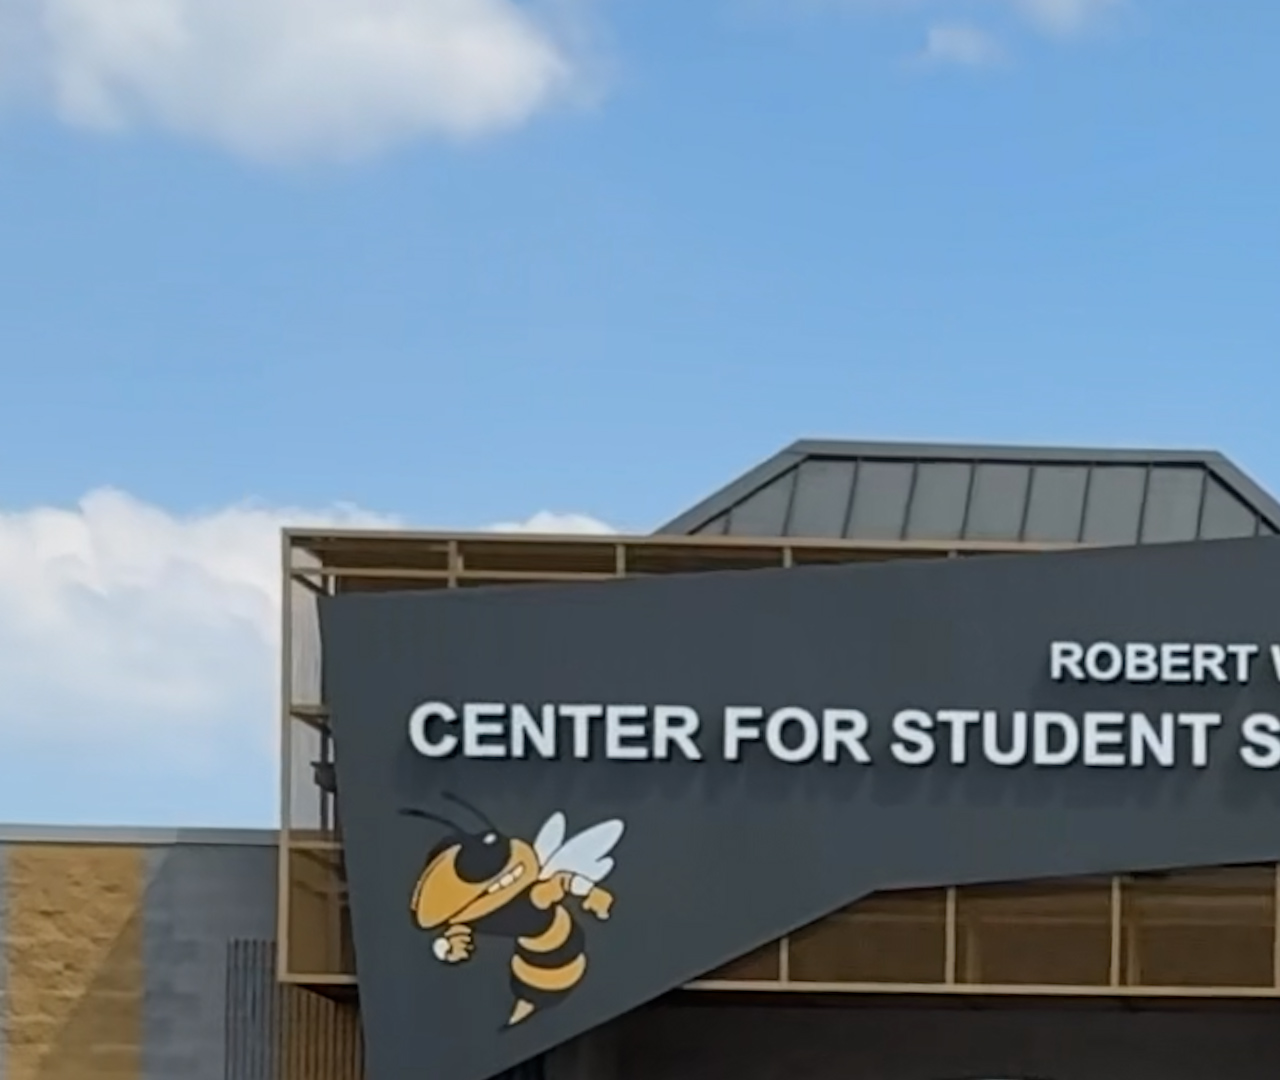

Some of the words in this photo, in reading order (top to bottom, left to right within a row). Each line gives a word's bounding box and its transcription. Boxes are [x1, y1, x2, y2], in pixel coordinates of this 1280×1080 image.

[1050, 641, 1258, 682] ROBERT
[408, 701, 702, 760] CENTER
[724, 706, 871, 763] FOR
[890, 709, 1222, 767] STUDENT
